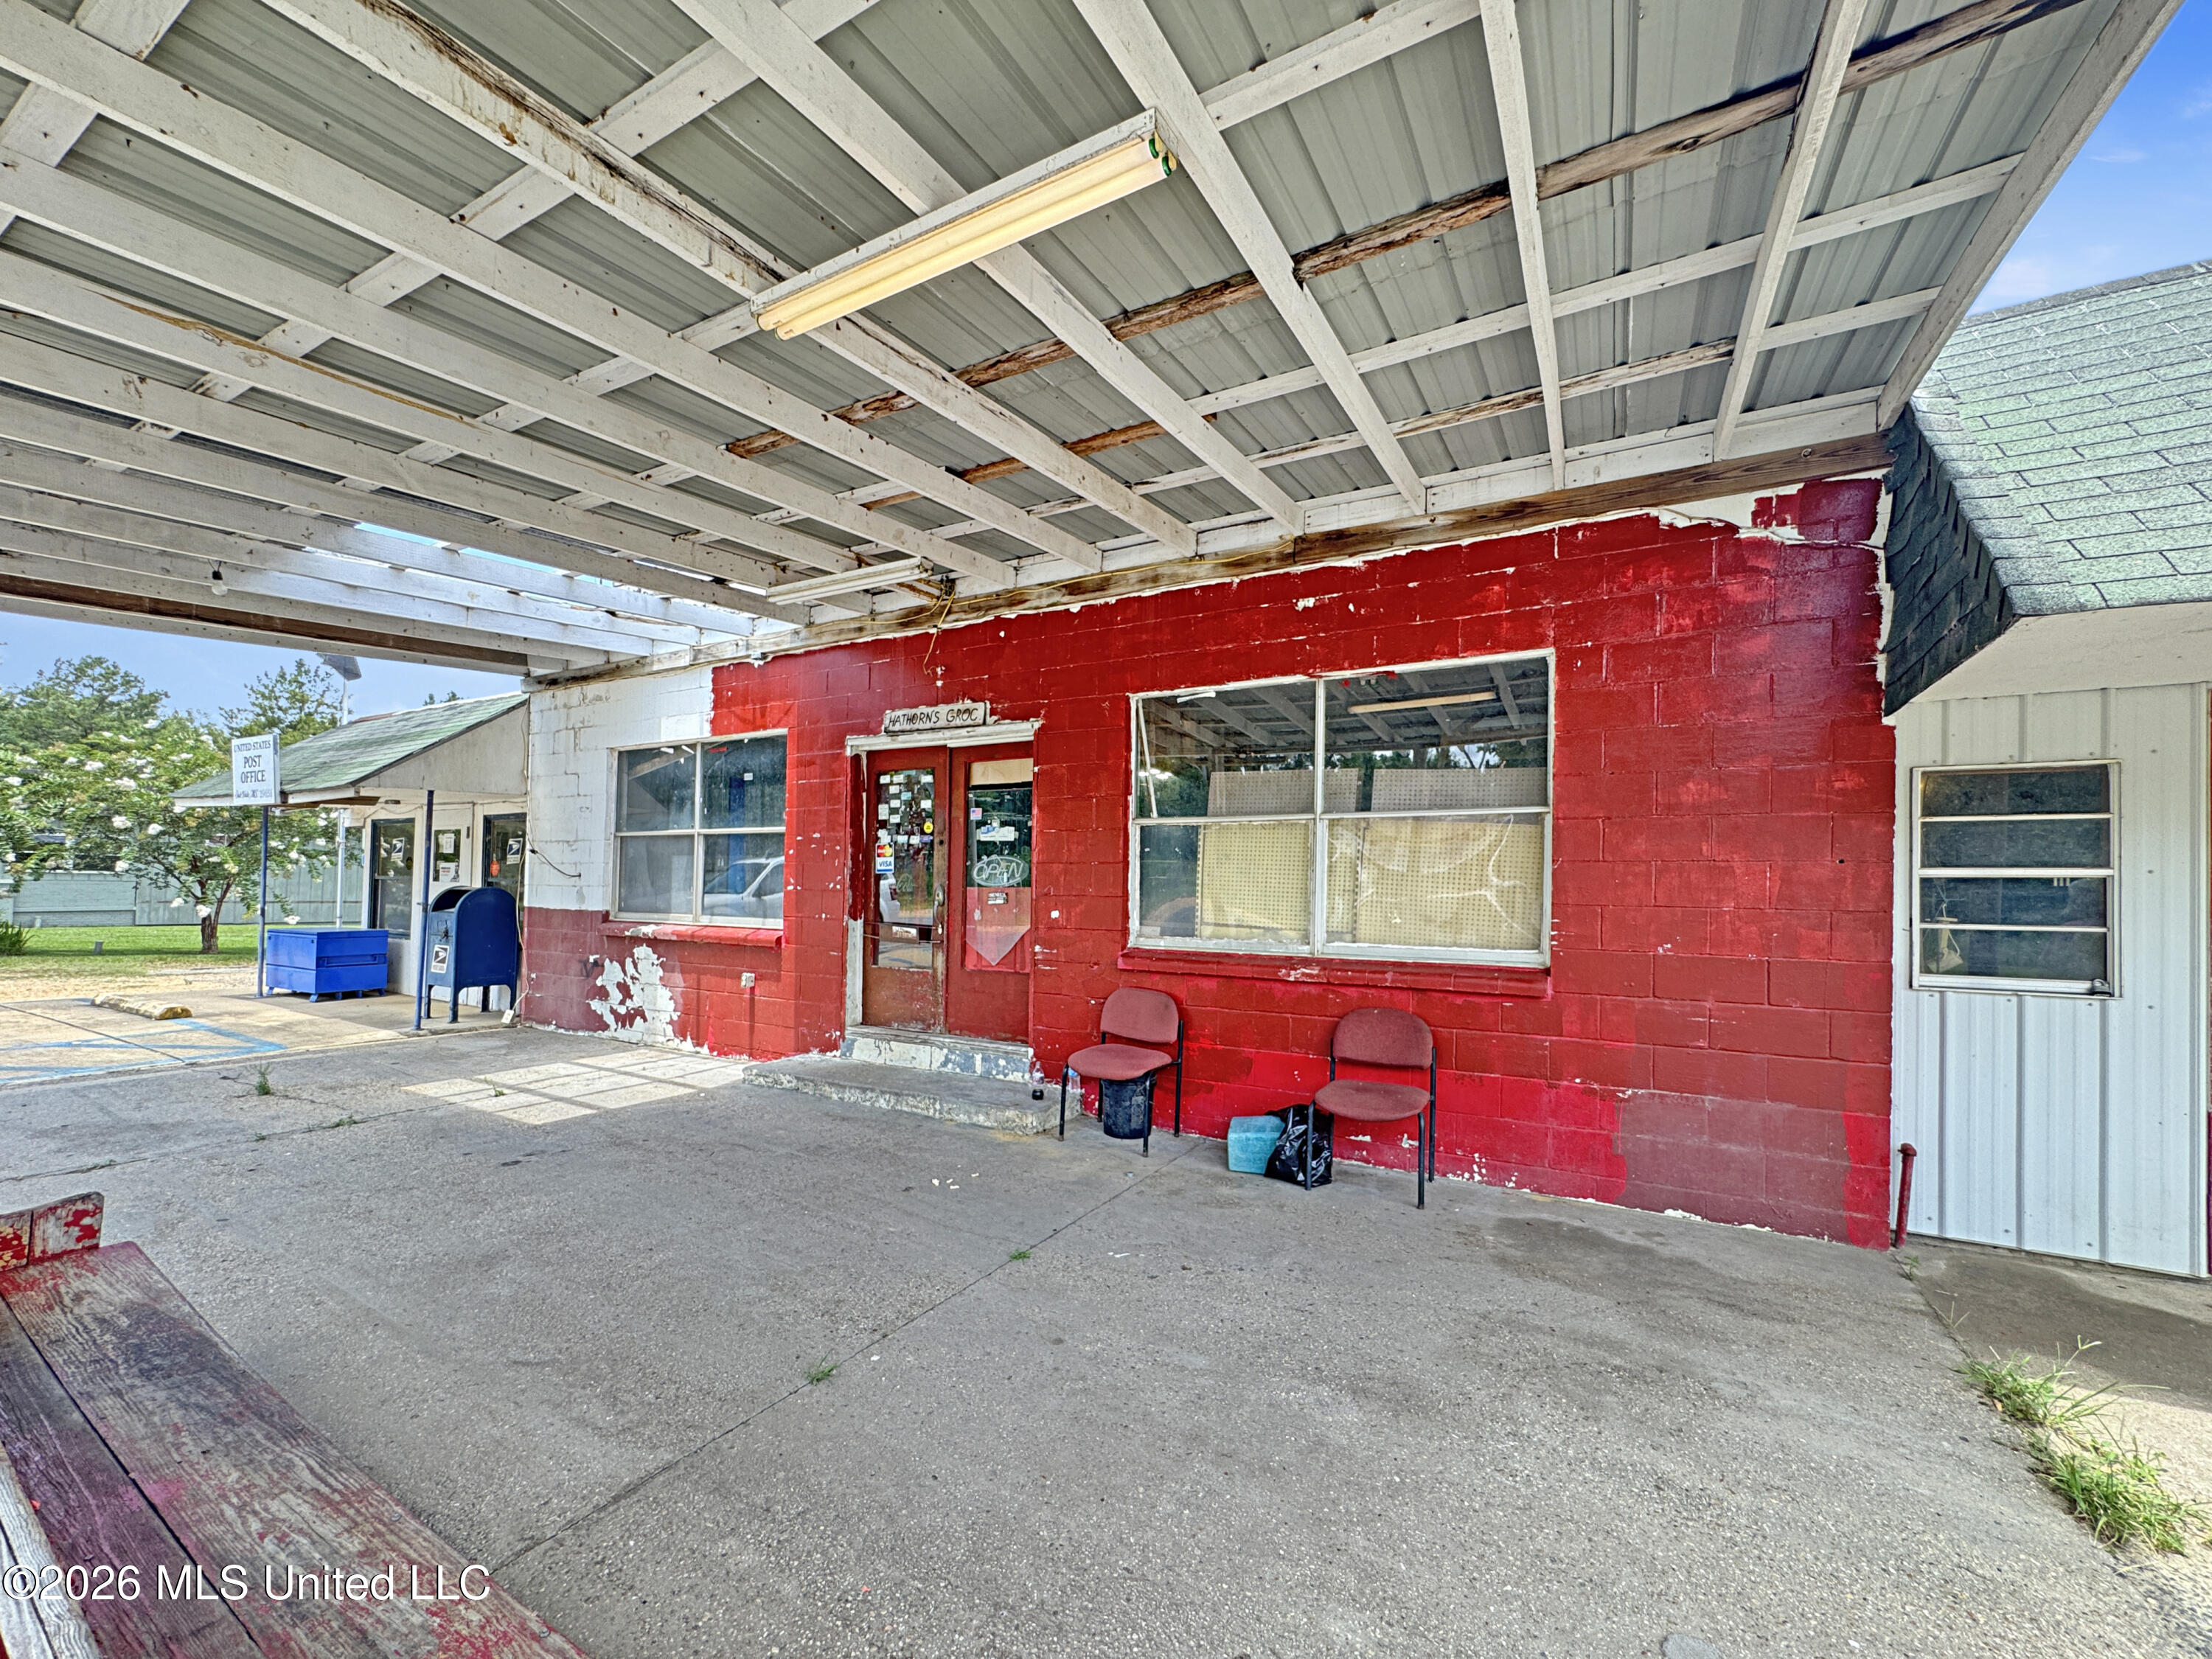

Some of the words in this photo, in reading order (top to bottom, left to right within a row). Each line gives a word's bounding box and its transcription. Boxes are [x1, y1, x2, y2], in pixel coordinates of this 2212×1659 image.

[888, 710, 939, 728] HATHORN'S
[946, 708, 978, 723] GROC
[234, 742, 251, 753] UNITED
[252, 740, 271, 751] STATES
[243, 755, 262, 768] POST
[240, 770, 266, 783] OFFICE
[973, 862, 1023, 879] OPEN
